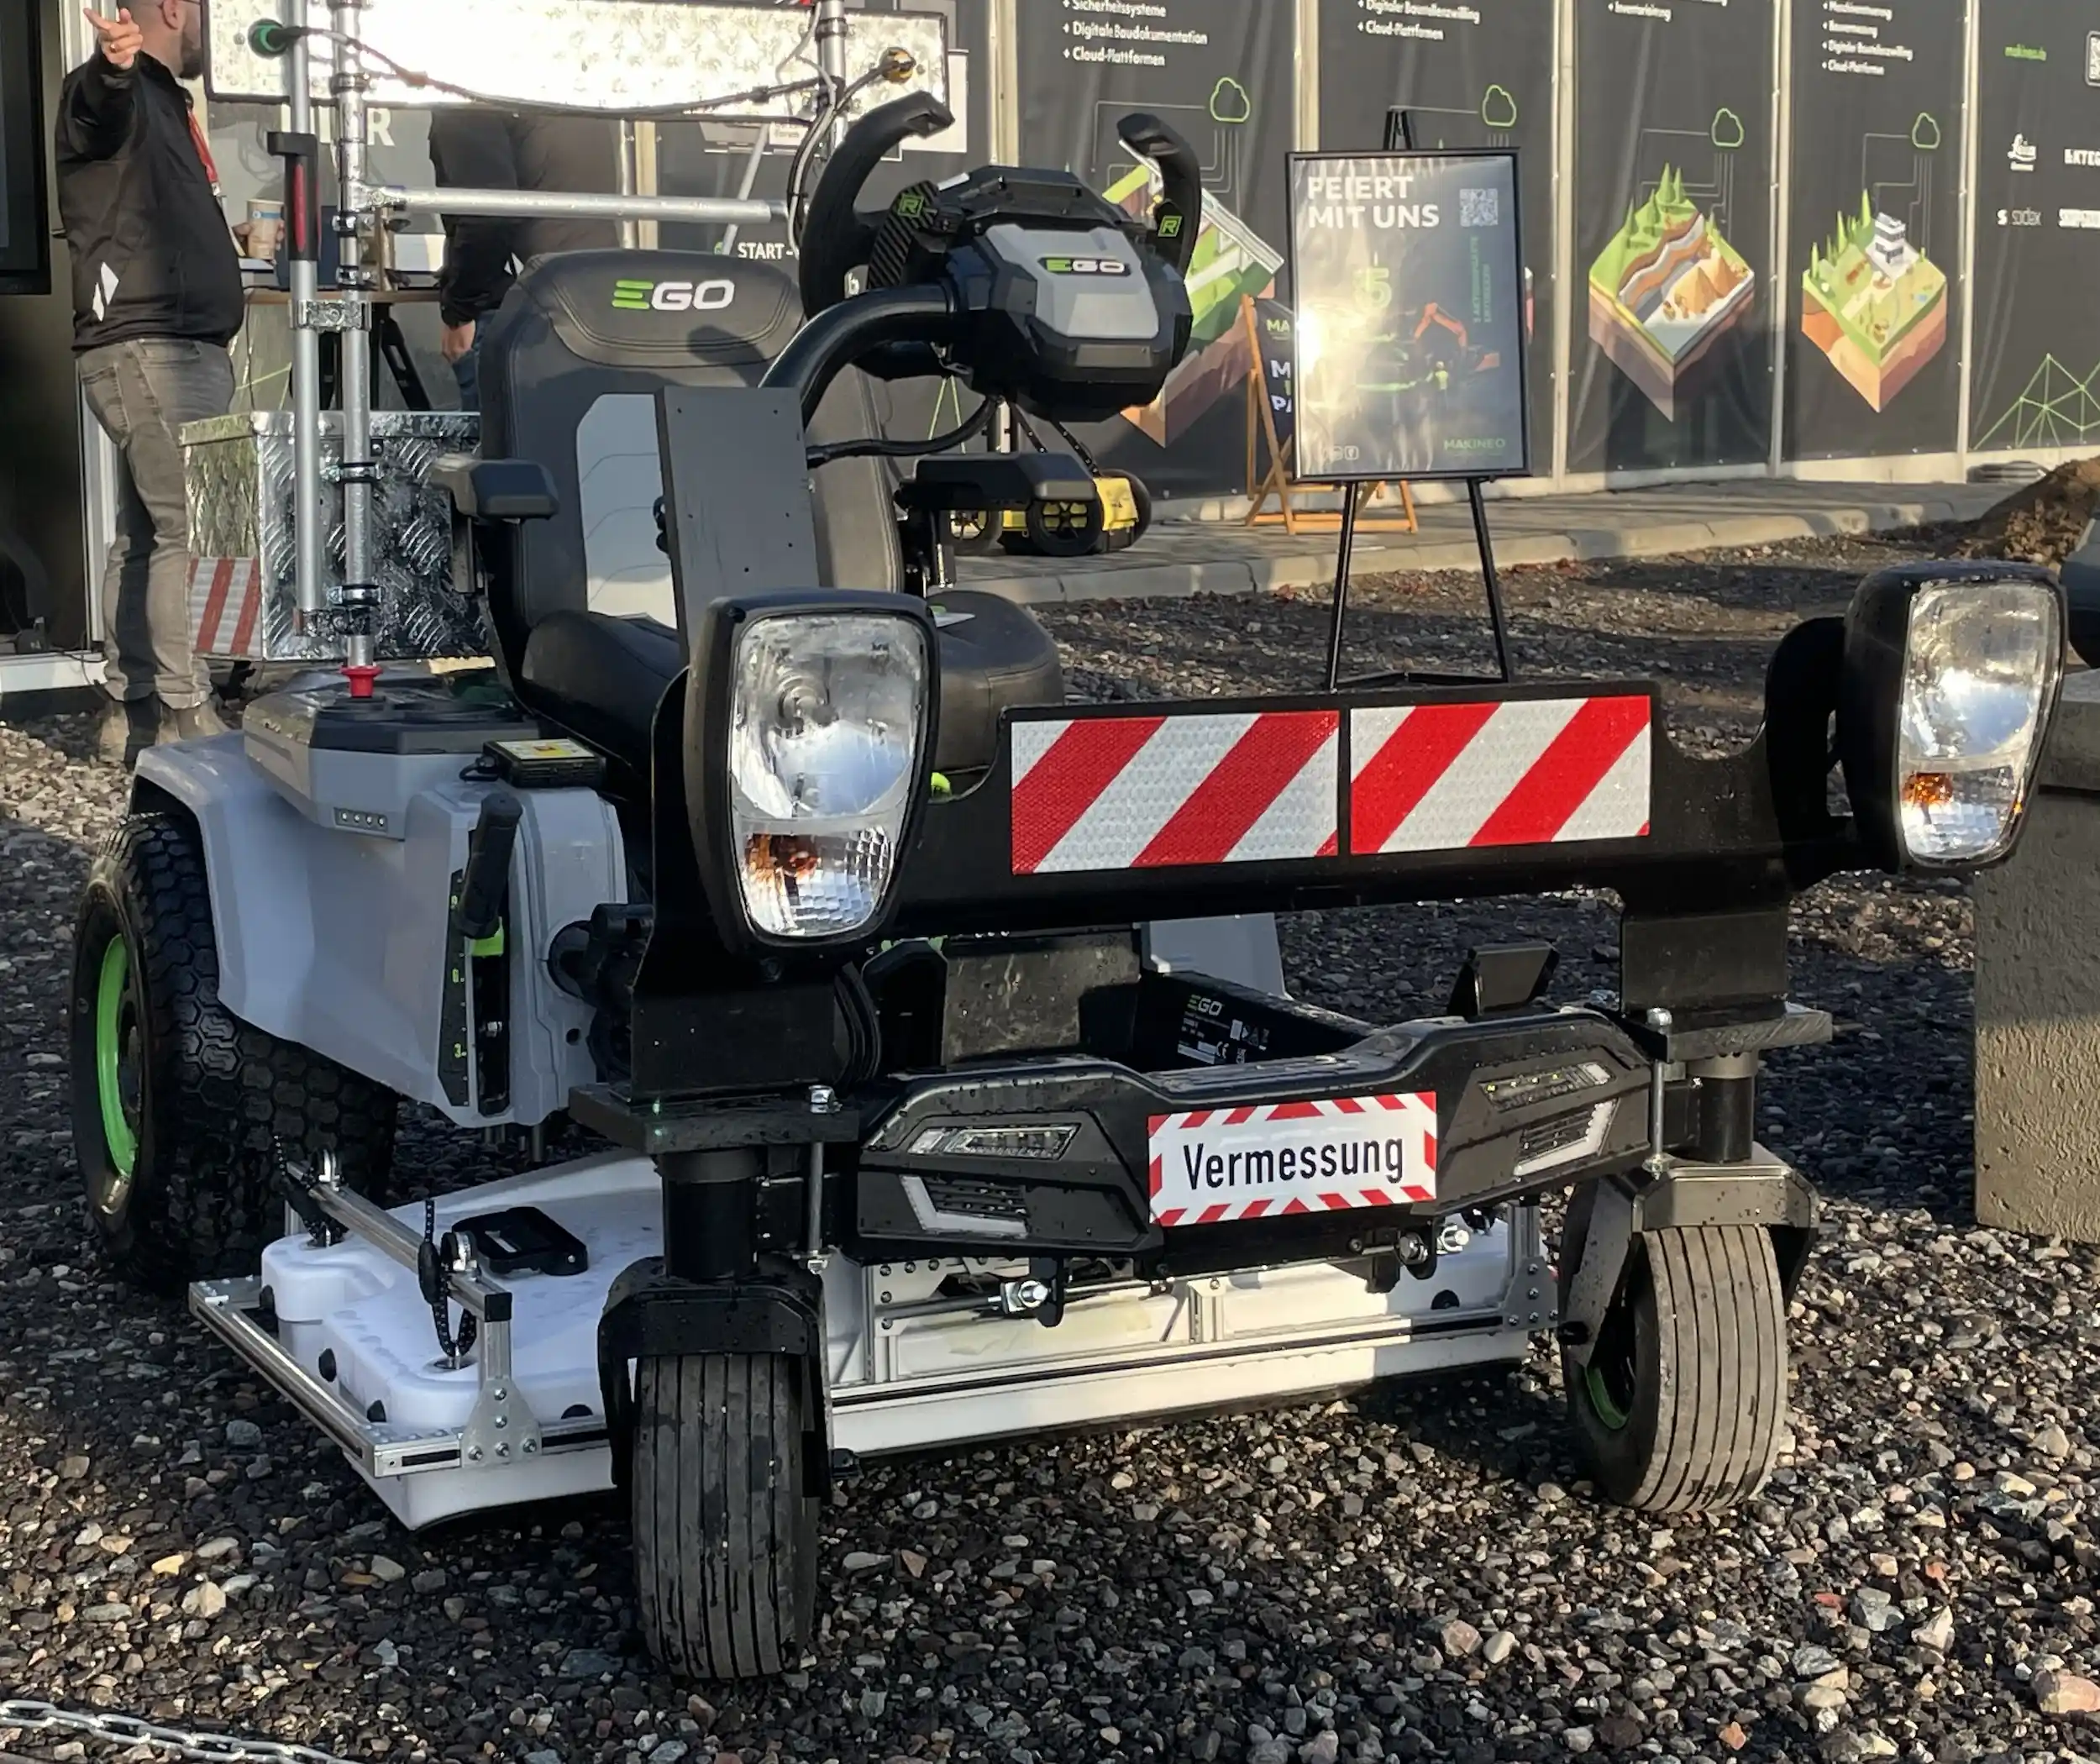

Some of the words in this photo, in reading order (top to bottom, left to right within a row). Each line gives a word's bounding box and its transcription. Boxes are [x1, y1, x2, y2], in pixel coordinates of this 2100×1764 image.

[1307, 176, 1415, 200] FEIERT
[1307, 206, 1366, 229] MIT
[1373, 204, 1440, 228] UNS
[1047, 260, 1125, 273] EGO
[612, 279, 735, 311] EGO
[1187, 994, 1223, 1016] EGO
[1183, 1137, 1403, 1190] Vermessung
